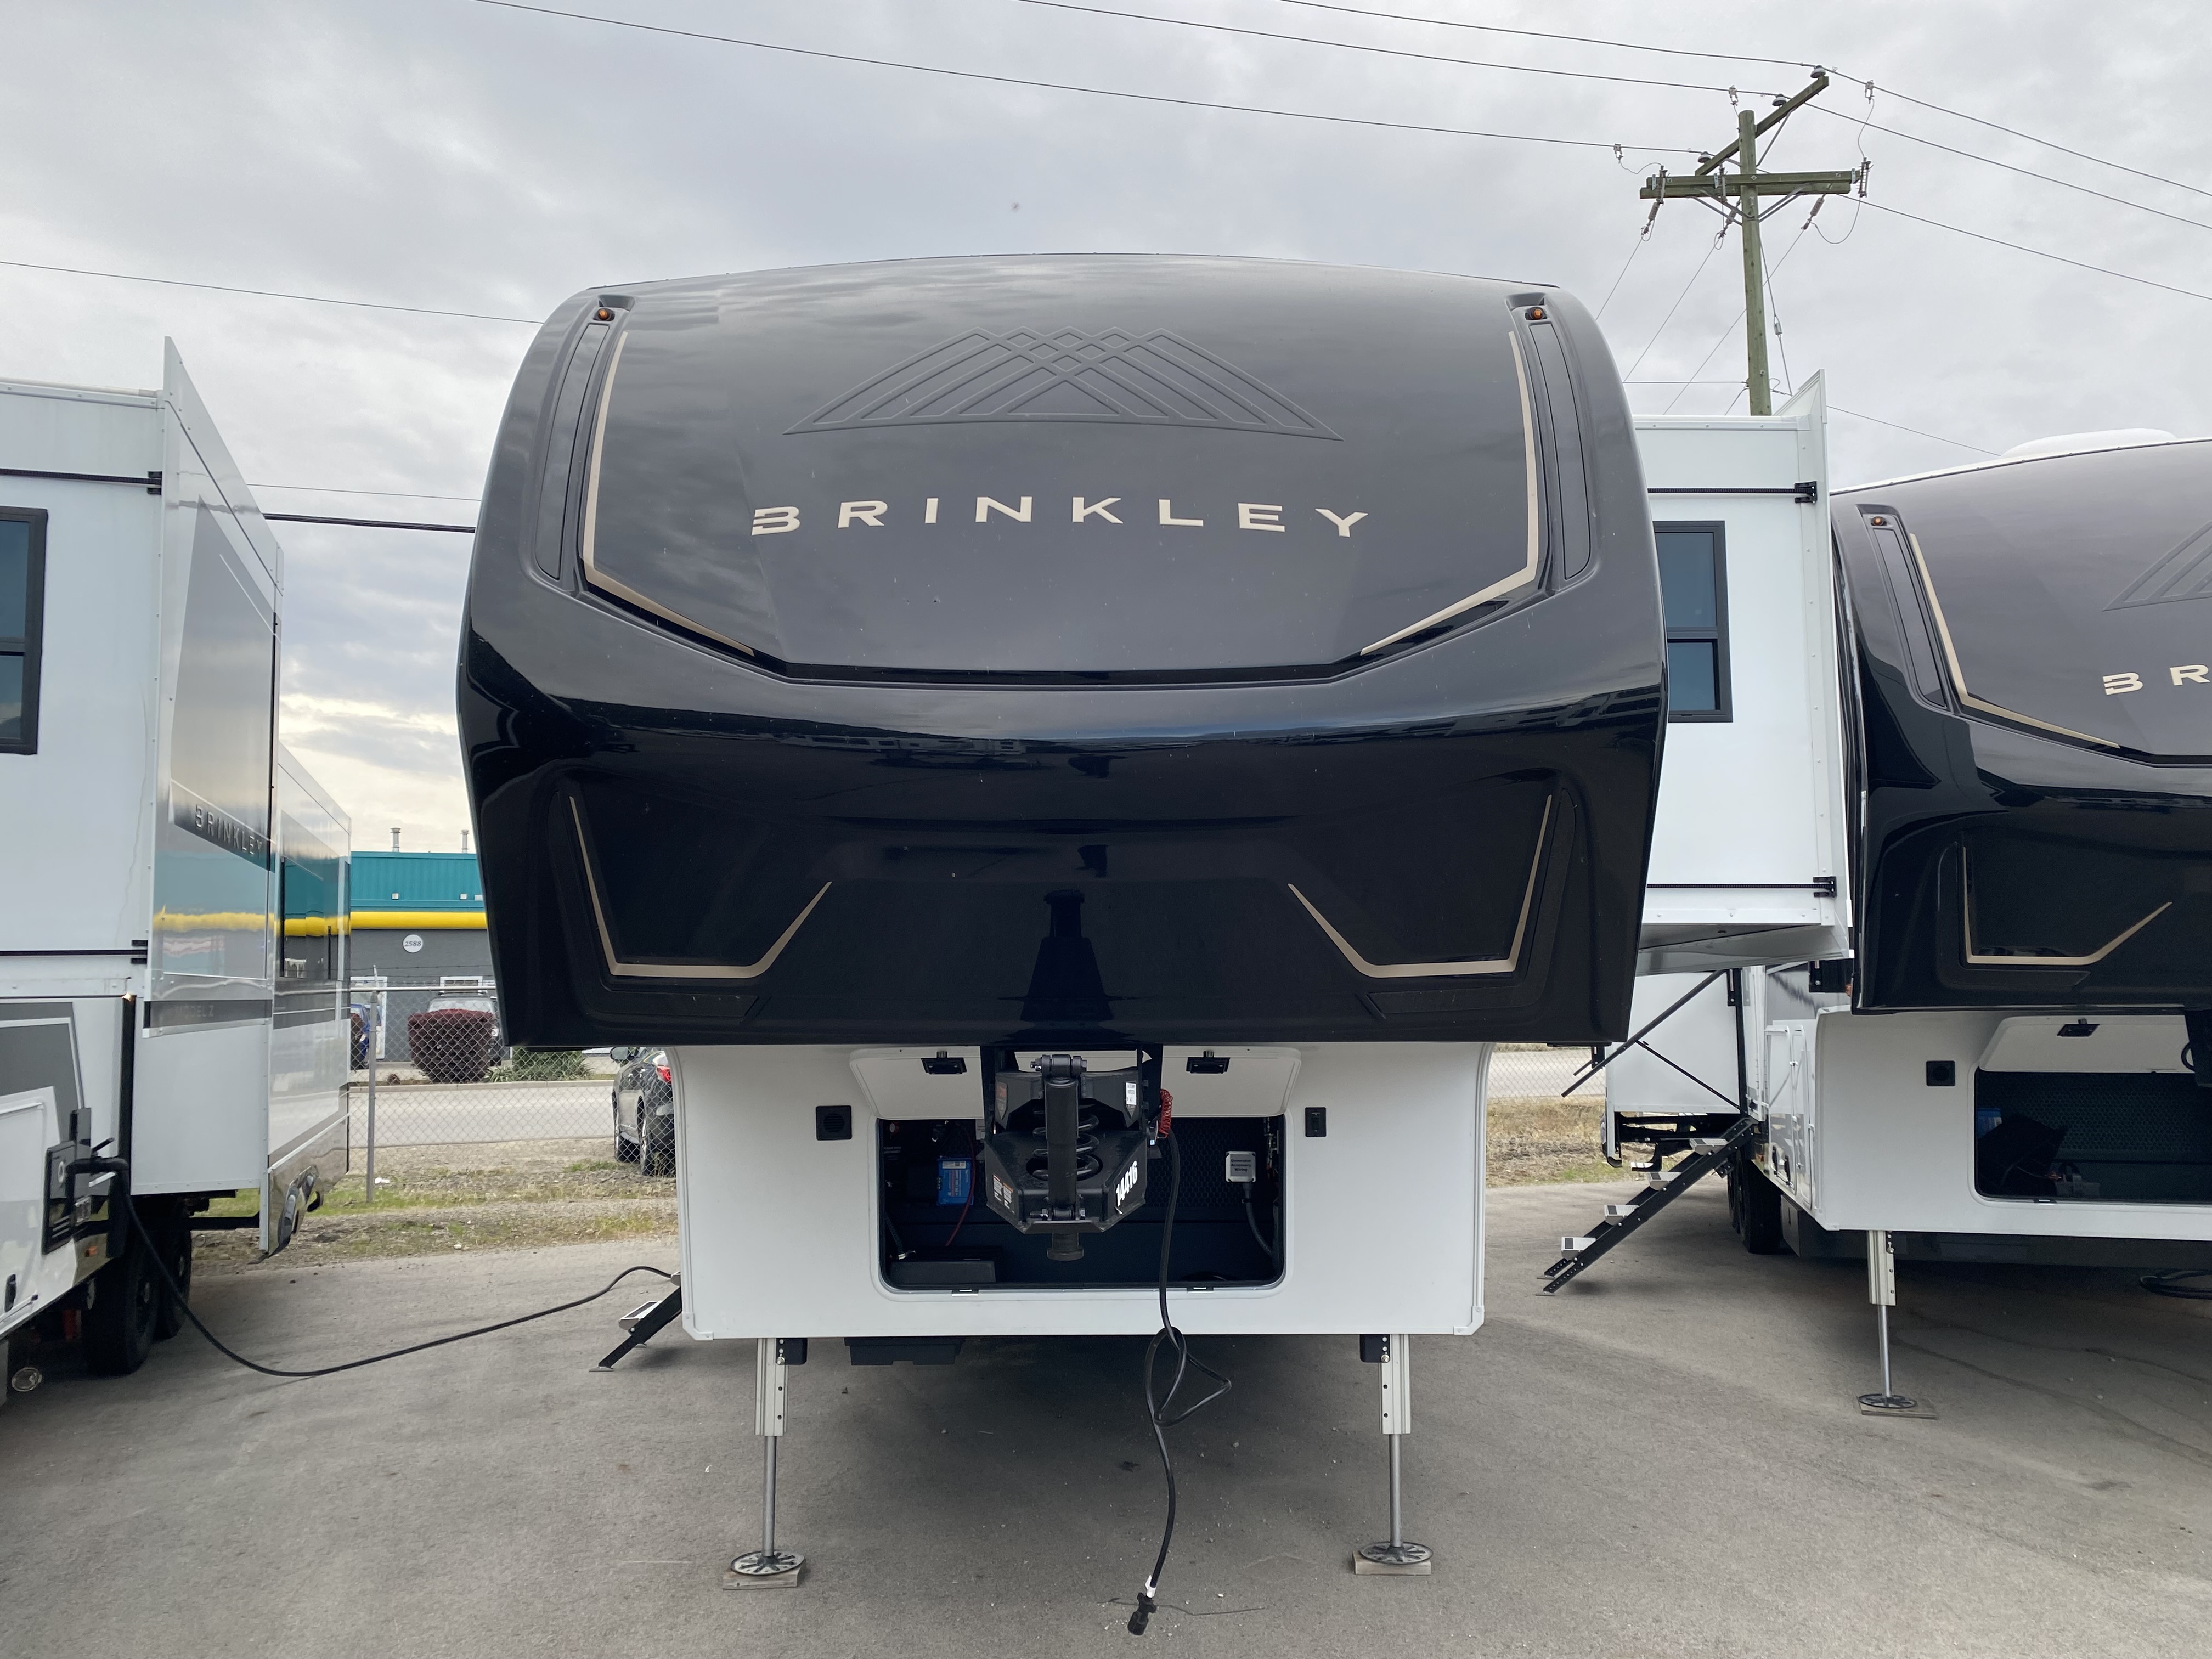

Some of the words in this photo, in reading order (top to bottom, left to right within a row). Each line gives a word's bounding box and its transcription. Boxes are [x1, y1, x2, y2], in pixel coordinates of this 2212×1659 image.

[751, 495, 1369, 538] BRINKLEY
[2102, 664, 2211, 696] BR
[195, 804, 262, 860] BRINKLEY
[1115, 1160, 1138, 1207] 14416
